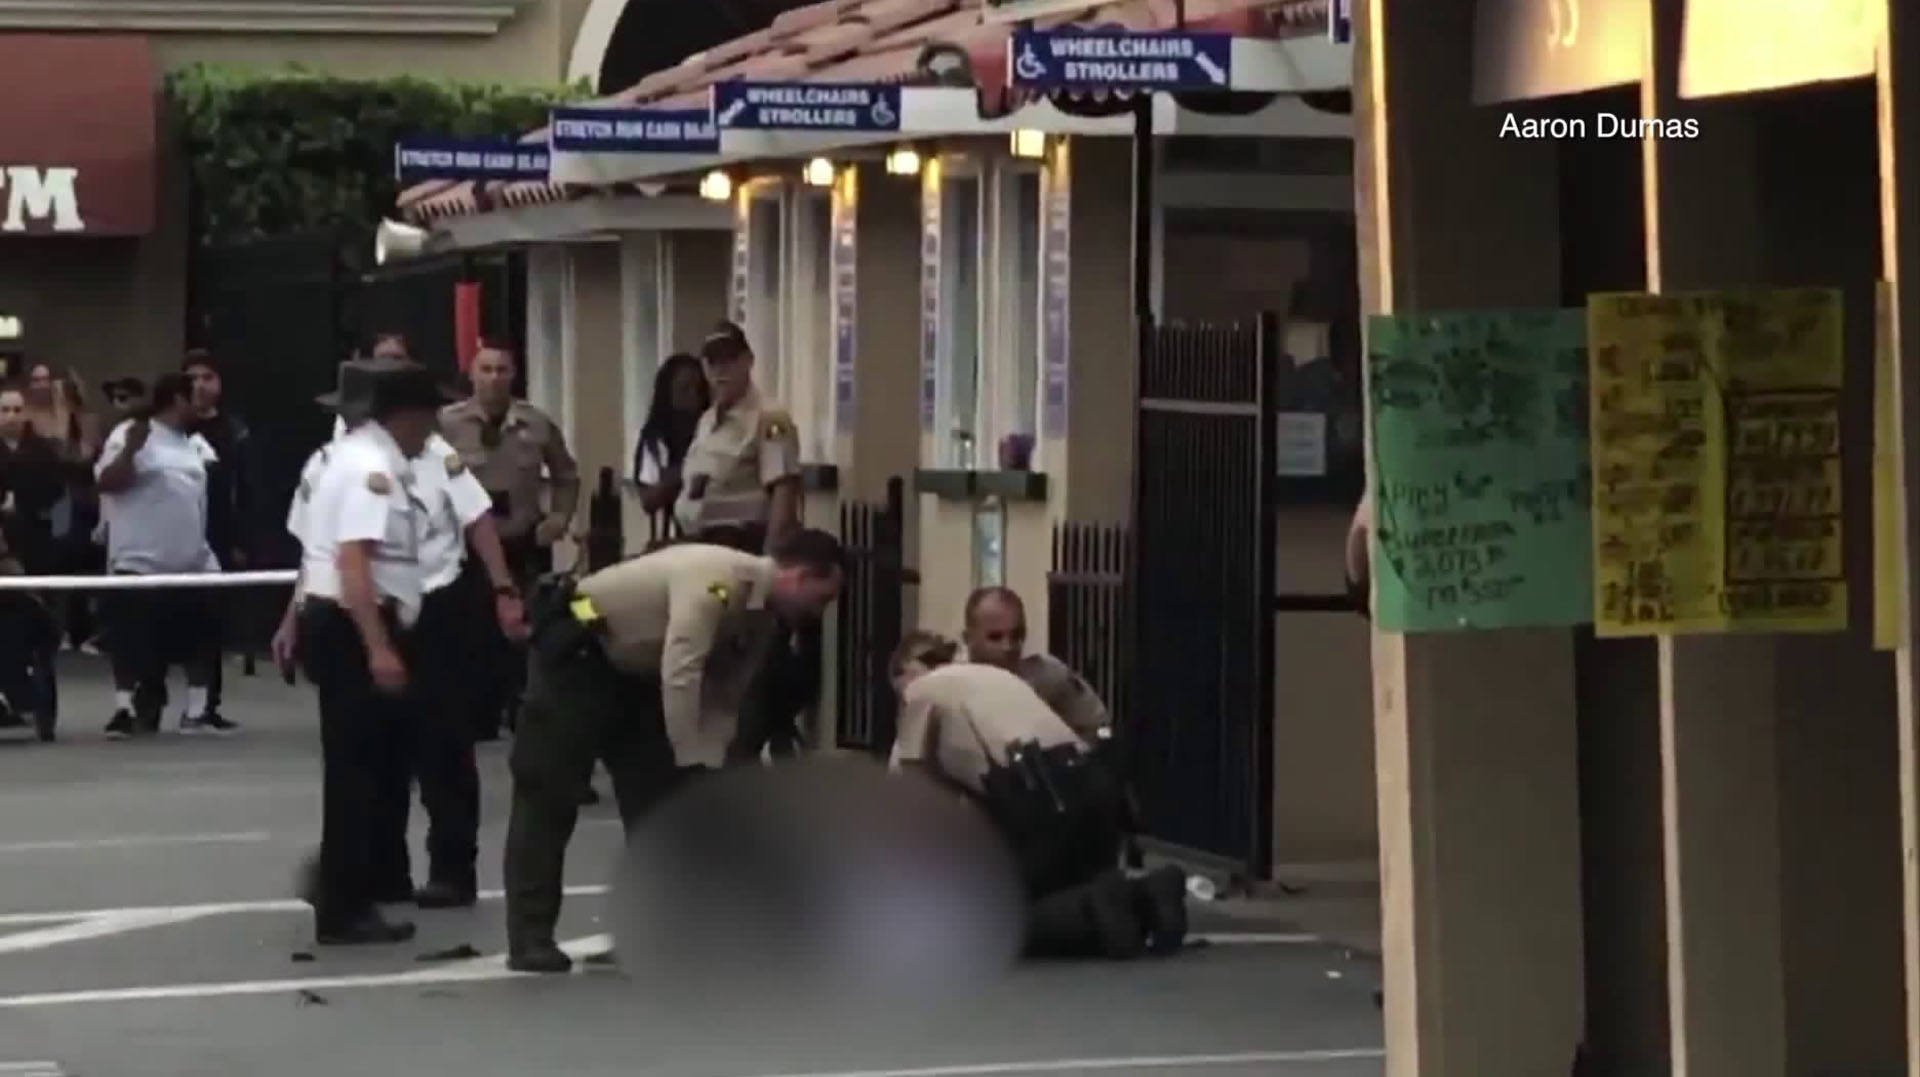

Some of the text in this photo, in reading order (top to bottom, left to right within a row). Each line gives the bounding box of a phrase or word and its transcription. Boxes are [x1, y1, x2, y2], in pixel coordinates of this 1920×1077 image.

[1050, 38, 1194, 58] WHEELCHAIRS
[1064, 61, 1179, 81] STROLLERS
[746, 87, 871, 104] WHEELCHAIRS
[758, 107, 857, 126] STROLLERS
